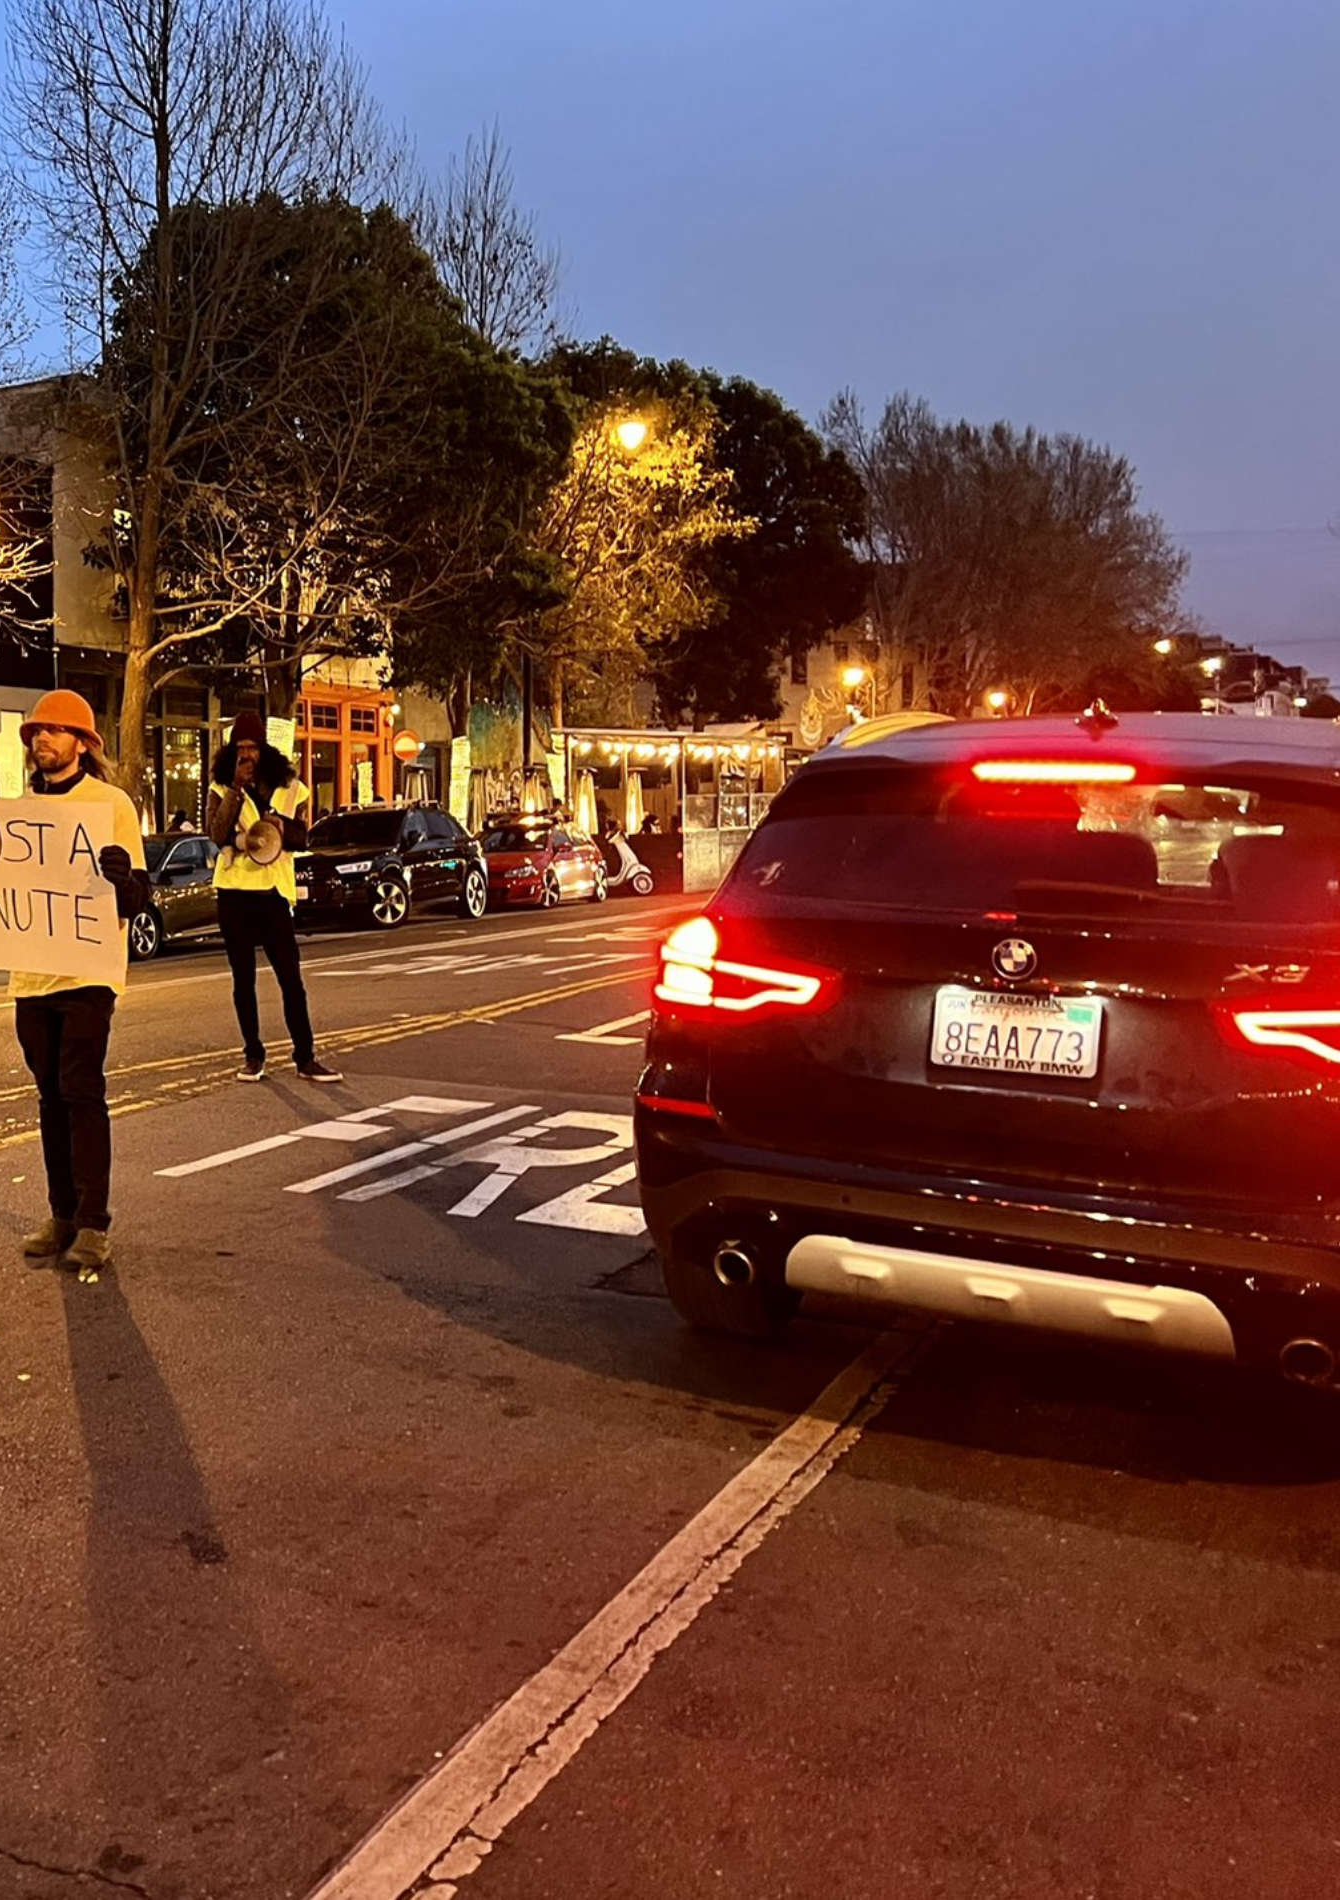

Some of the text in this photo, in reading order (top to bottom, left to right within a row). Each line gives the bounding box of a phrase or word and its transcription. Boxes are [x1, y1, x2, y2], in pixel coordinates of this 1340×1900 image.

[69, 822, 100, 877] A
[1223, 964, 1310, 984] X3
[974, 993, 1060, 1009] PLEASANTON
[945, 1021, 1084, 1063] 8EAA773
[961, 1056, 1084, 1075] EAST BAY BMW
